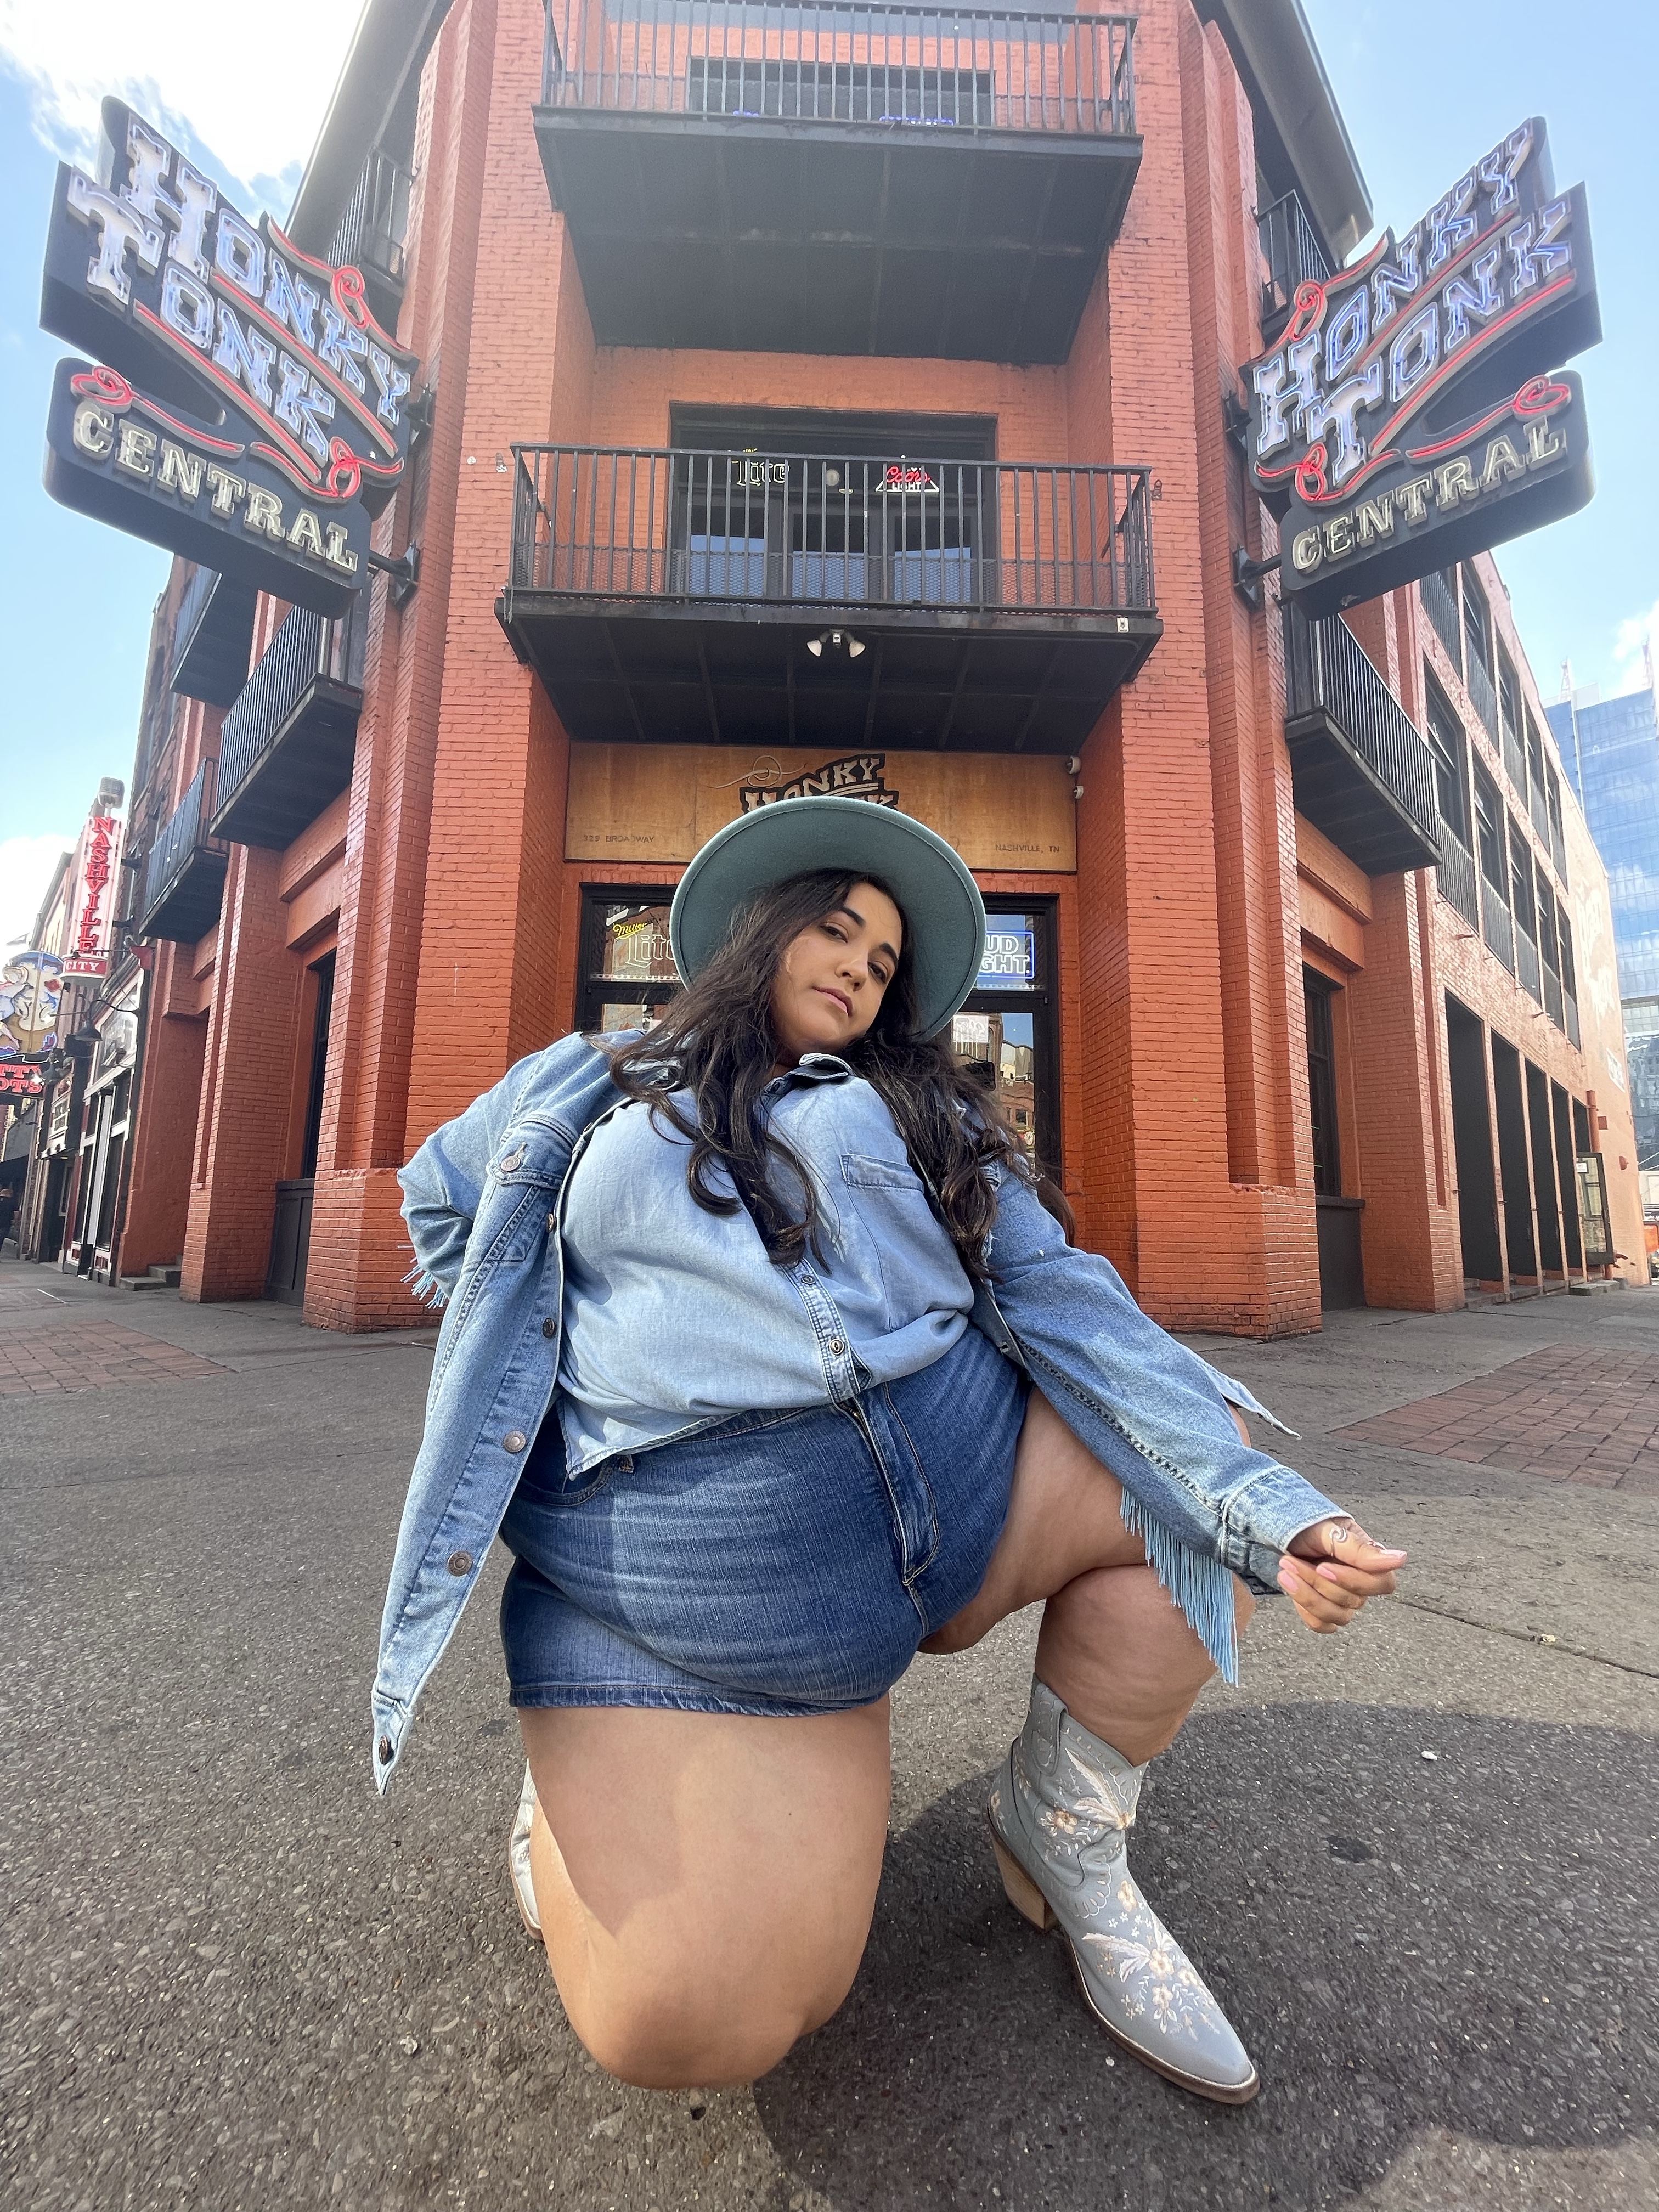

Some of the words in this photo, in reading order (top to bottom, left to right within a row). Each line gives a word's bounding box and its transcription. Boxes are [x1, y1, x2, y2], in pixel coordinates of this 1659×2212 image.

[67, 165, 336, 469] TONK
[120, 112, 410, 428] HONKY
[1252, 116, 1533, 460] HONKY
[1306, 189, 1572, 487] TONK
[72, 404, 358, 576] CENTRAL
[1291, 416, 1568, 575] CENTRAL
[77, 816, 114, 955] NASHVILLE
[605, 835, 654, 843] BROADWAY
[66, 961, 100, 972] CITY
[613, 923, 648, 936] Miller
[984, 935, 1019, 955] UD
